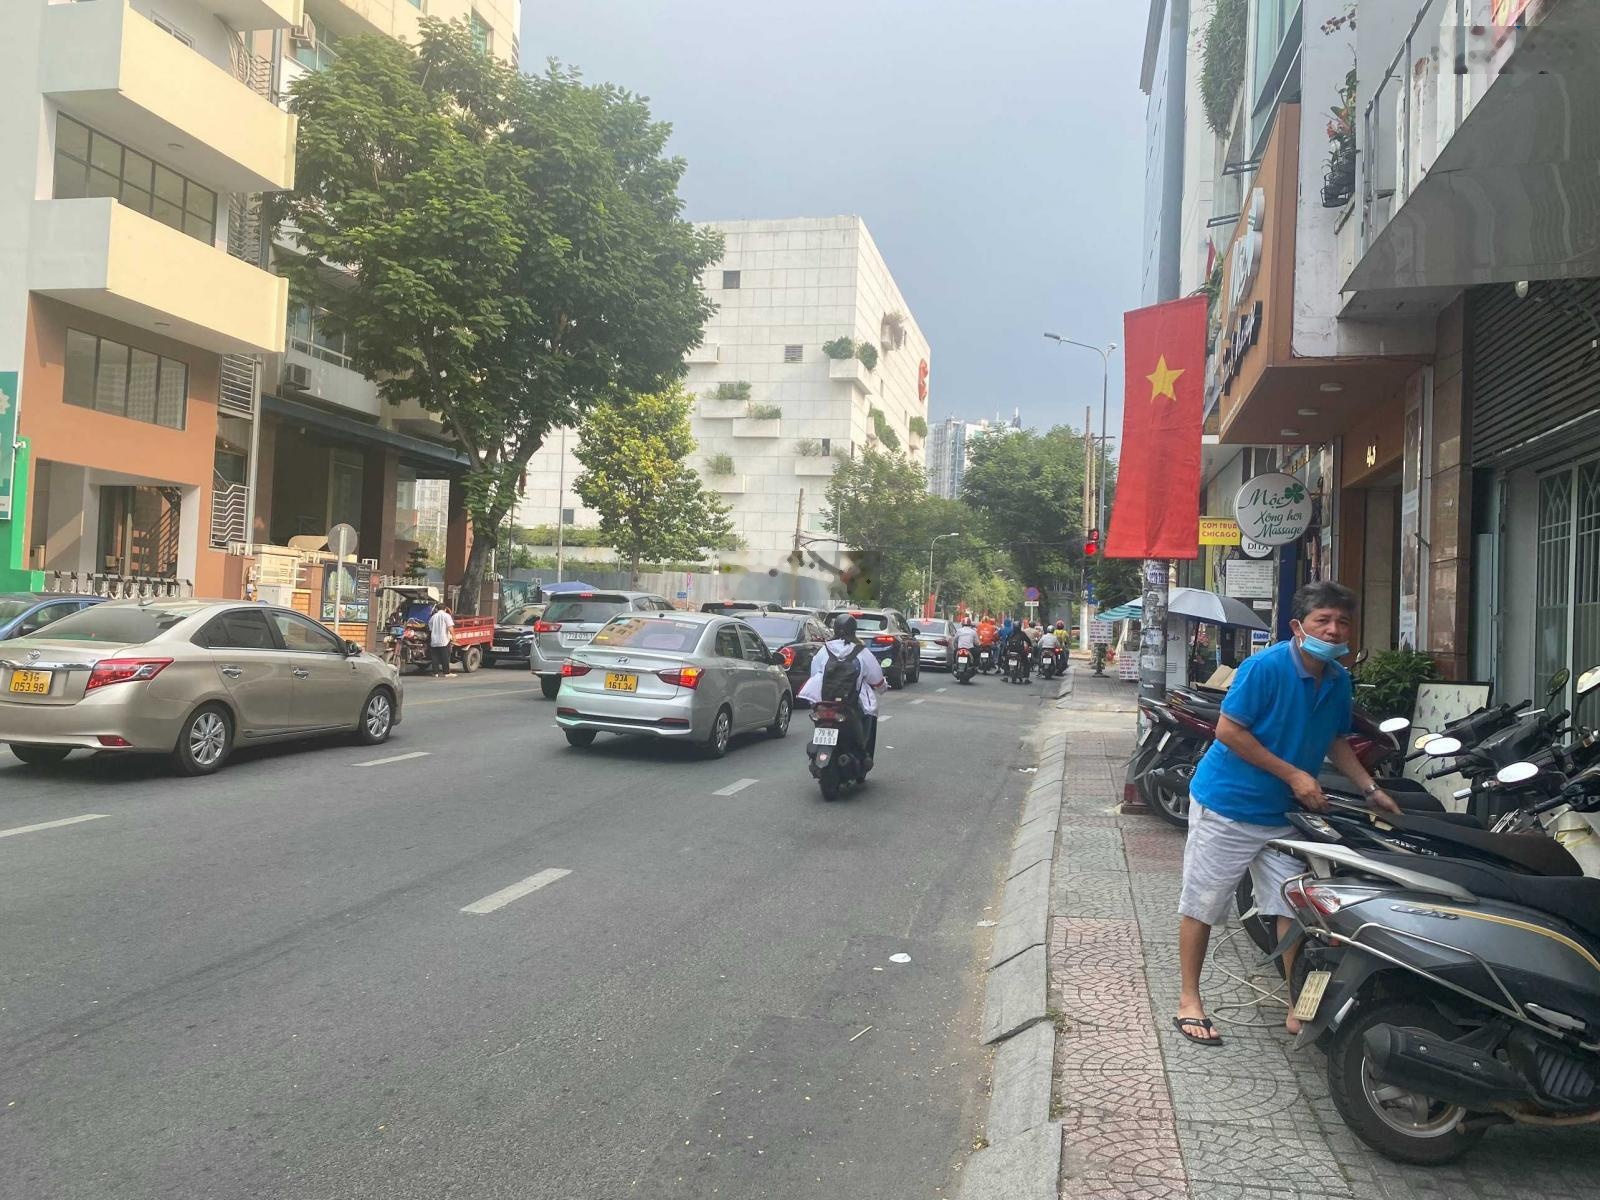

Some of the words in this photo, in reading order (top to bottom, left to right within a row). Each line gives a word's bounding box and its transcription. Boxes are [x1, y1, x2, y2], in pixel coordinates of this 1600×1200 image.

[1238, 488, 1292, 509] Mộc
[1253, 509, 1283, 526] Xông
[1254, 523, 1304, 539] Massage
[23, 672, 40, 682] 51G
[614, 673, 628, 682] 93A
